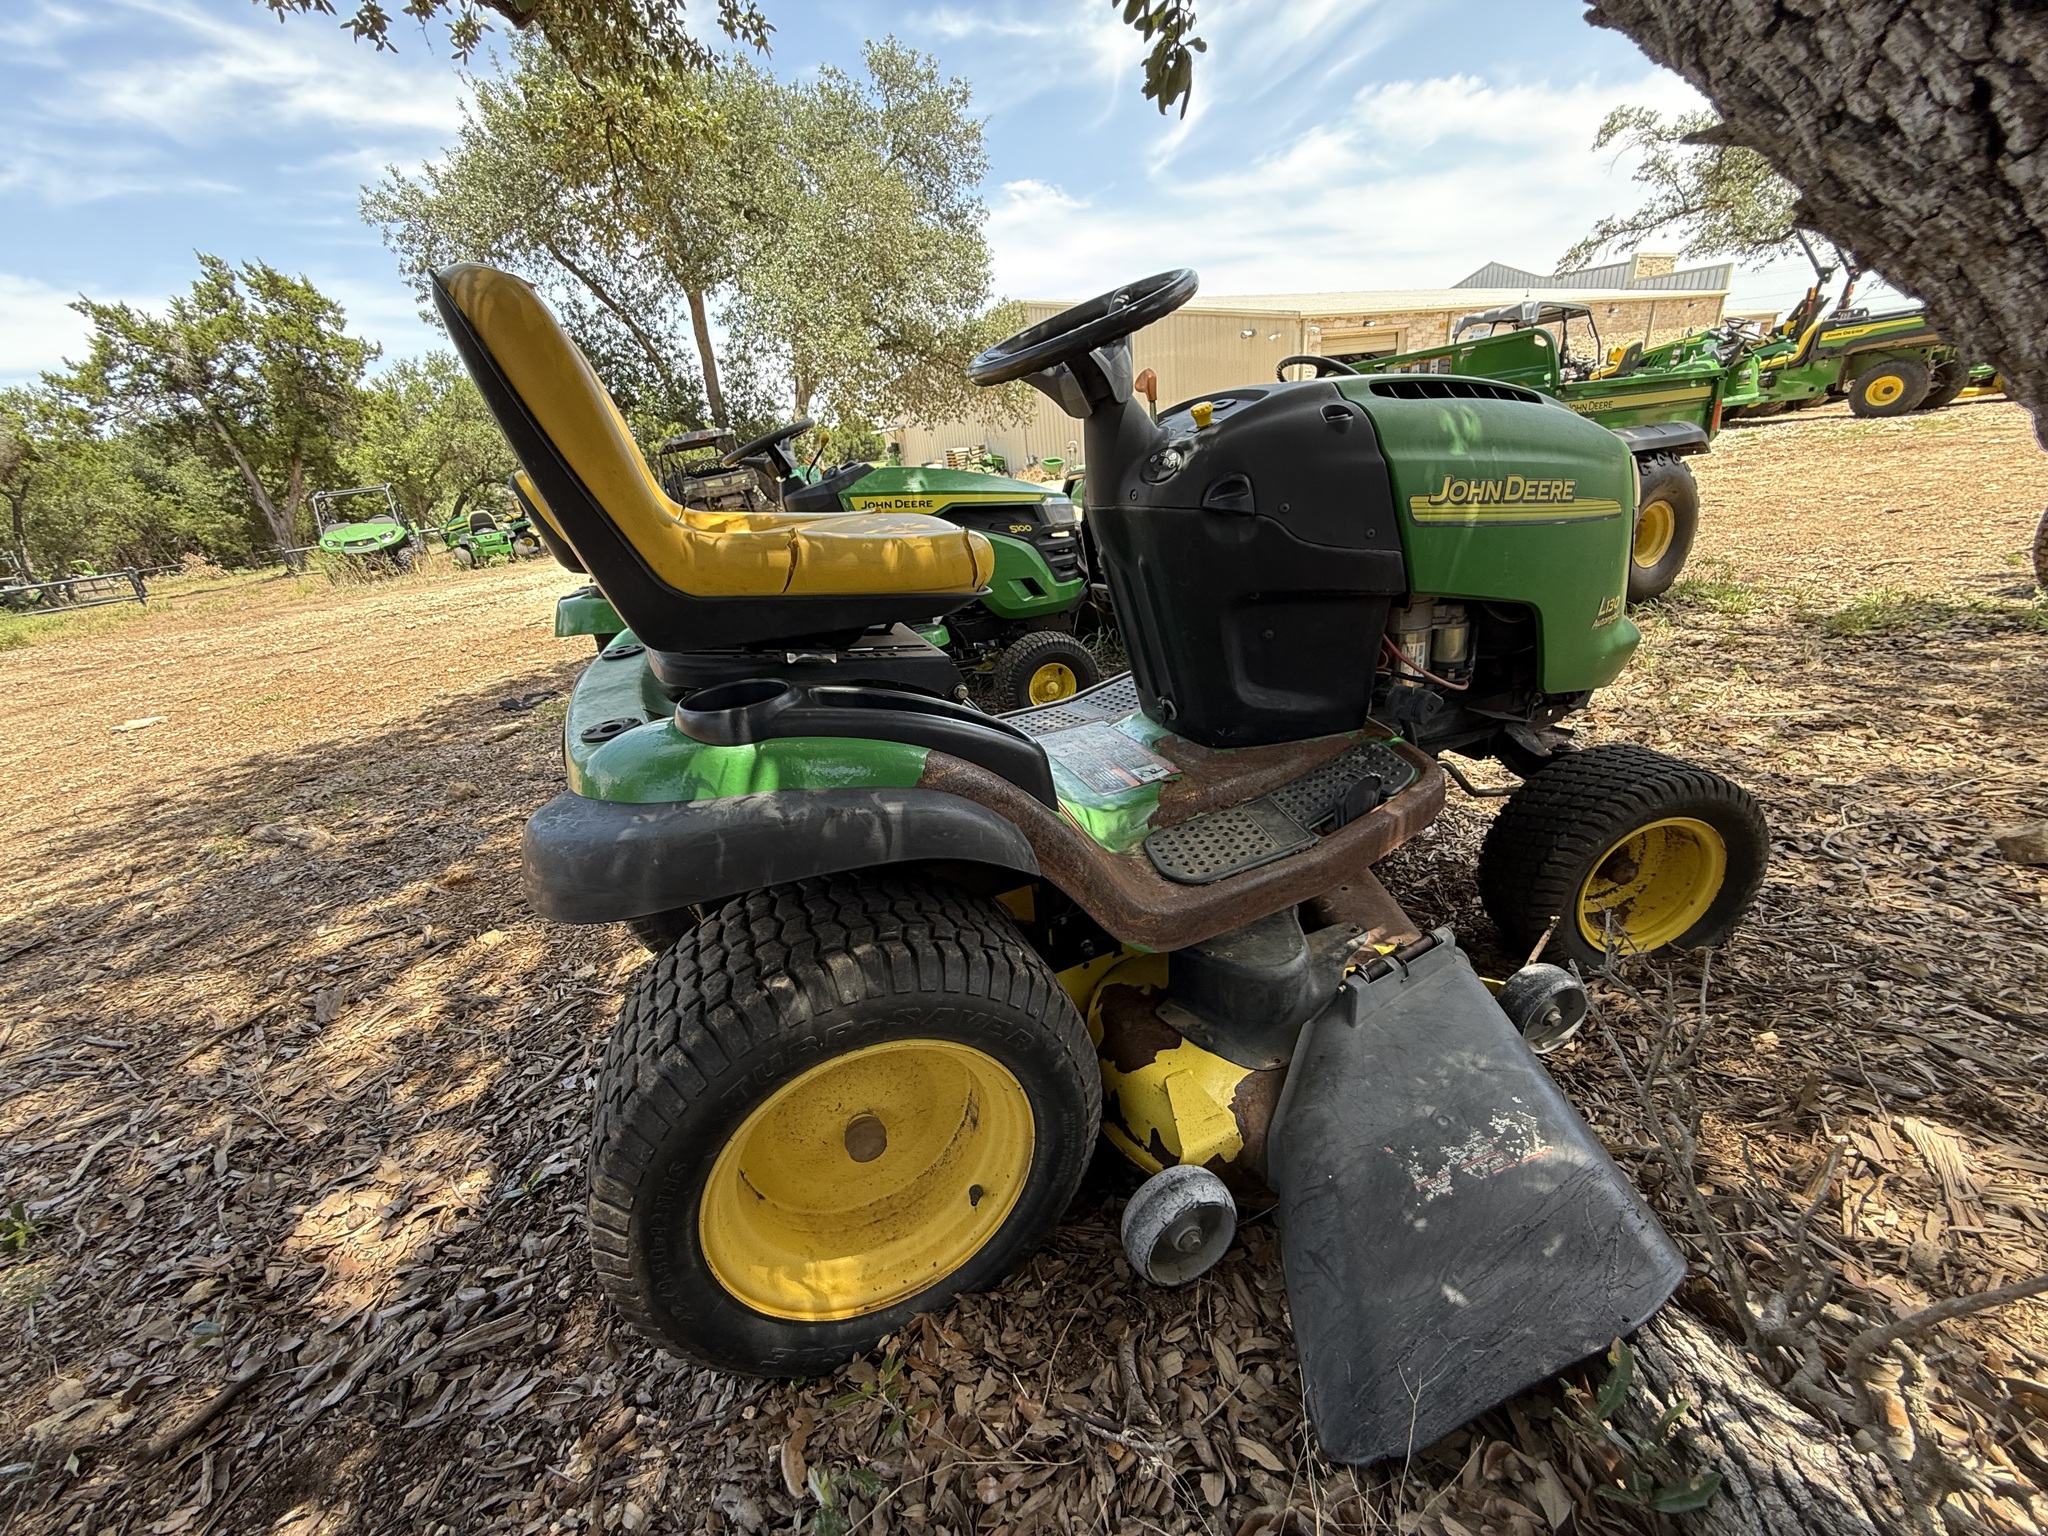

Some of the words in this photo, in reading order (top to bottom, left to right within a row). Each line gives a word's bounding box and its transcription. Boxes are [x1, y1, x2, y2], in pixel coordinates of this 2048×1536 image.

[1589, 401, 1613, 411] DEERE
[1428, 474, 1502, 505] JOHN
[1503, 474, 1576, 504] DEERE
[861, 500, 892, 510] JOHN
[894, 499, 933, 508] DEERE
[1009, 524, 1032, 534] S100
[1597, 595, 1620, 617] L130
[888, 1006, 1036, 1052] SAVER
